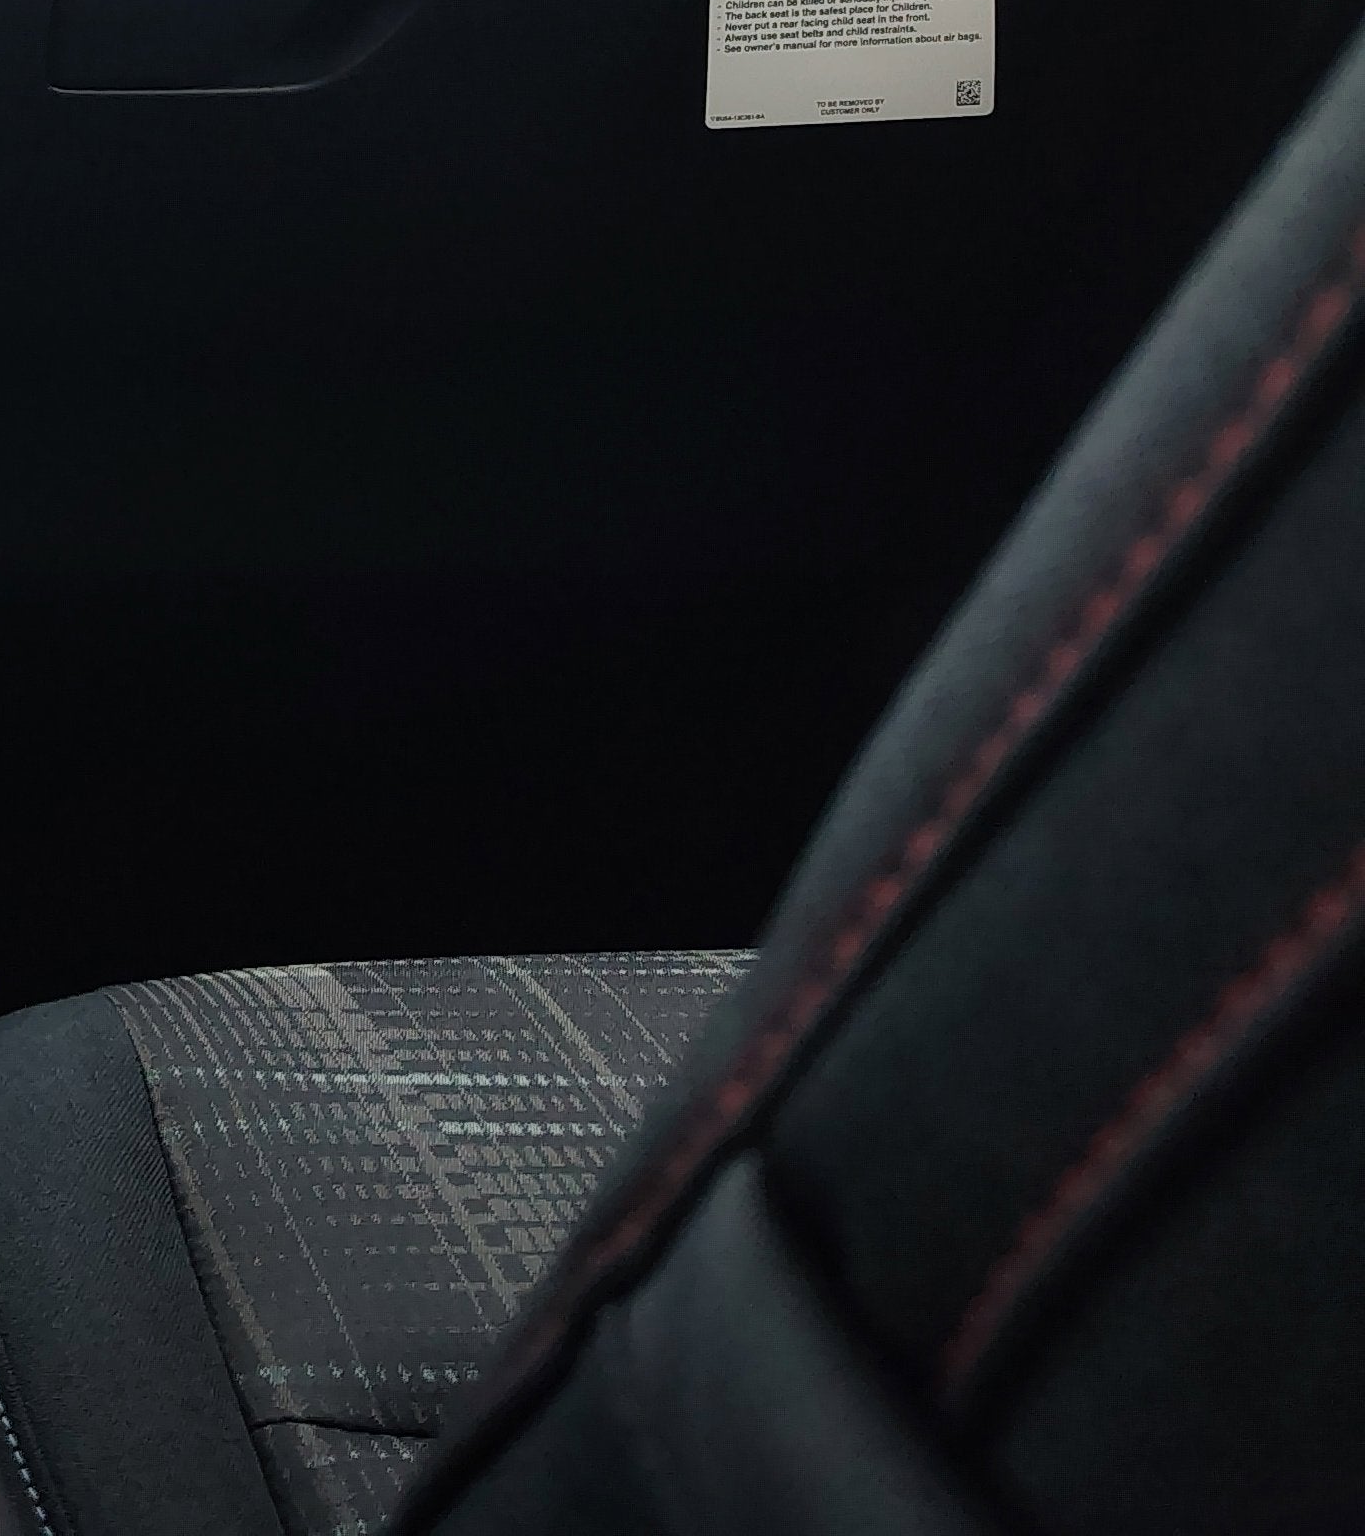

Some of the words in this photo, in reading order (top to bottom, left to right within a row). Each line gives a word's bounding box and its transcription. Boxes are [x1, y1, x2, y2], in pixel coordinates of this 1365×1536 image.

[725, 0, 765, 10] Children
[767, 0, 784, 8] can
[725, 11, 743, 21] The
[745, 10, 768, 19] back
[770, 10, 789, 18] seat
[792, 9, 799, 17] is
[802, 8, 816, 16] the
[819, 6, 847, 15] safest
[849, 5, 873, 15] place
[876, 5, 889, 13] for
[891, 3, 932, 12] Children.
[725, 23, 752, 32] Never
[754, 21, 770, 31] put
[780, 21, 798, 29] rear
[801, 18, 829, 28] facing
[831, 16, 854, 26] child
[856, 16, 875, 24] seat
[878, 15, 886, 23] in
[889, 14, 903, 22] the
[906, 13, 930, 22] front.
[724, 33, 758, 43] Always
[760, 32, 777, 40] use
[780, 30, 799, 39] seat
[802, 29, 824, 38] belts
[826, 28, 844, 37] and
[846, 26, 869, 36] child
[870, 25, 917, 35] restraints.
[724, 44, 742, 53] See
[744, 42, 781, 52] owner's
[783, 41, 817, 50] manual
[819, 40, 832, 48] for
[834, 39, 858, 48] more
[860, 36, 913, 46] information
[915, 34, 941, 44] about
[943, 33, 955, 42] air
[957, 33, 982, 43] bags.
[820, 107, 860, 116] CUSTOMER
[839, 99, 873, 107] REMOVED
